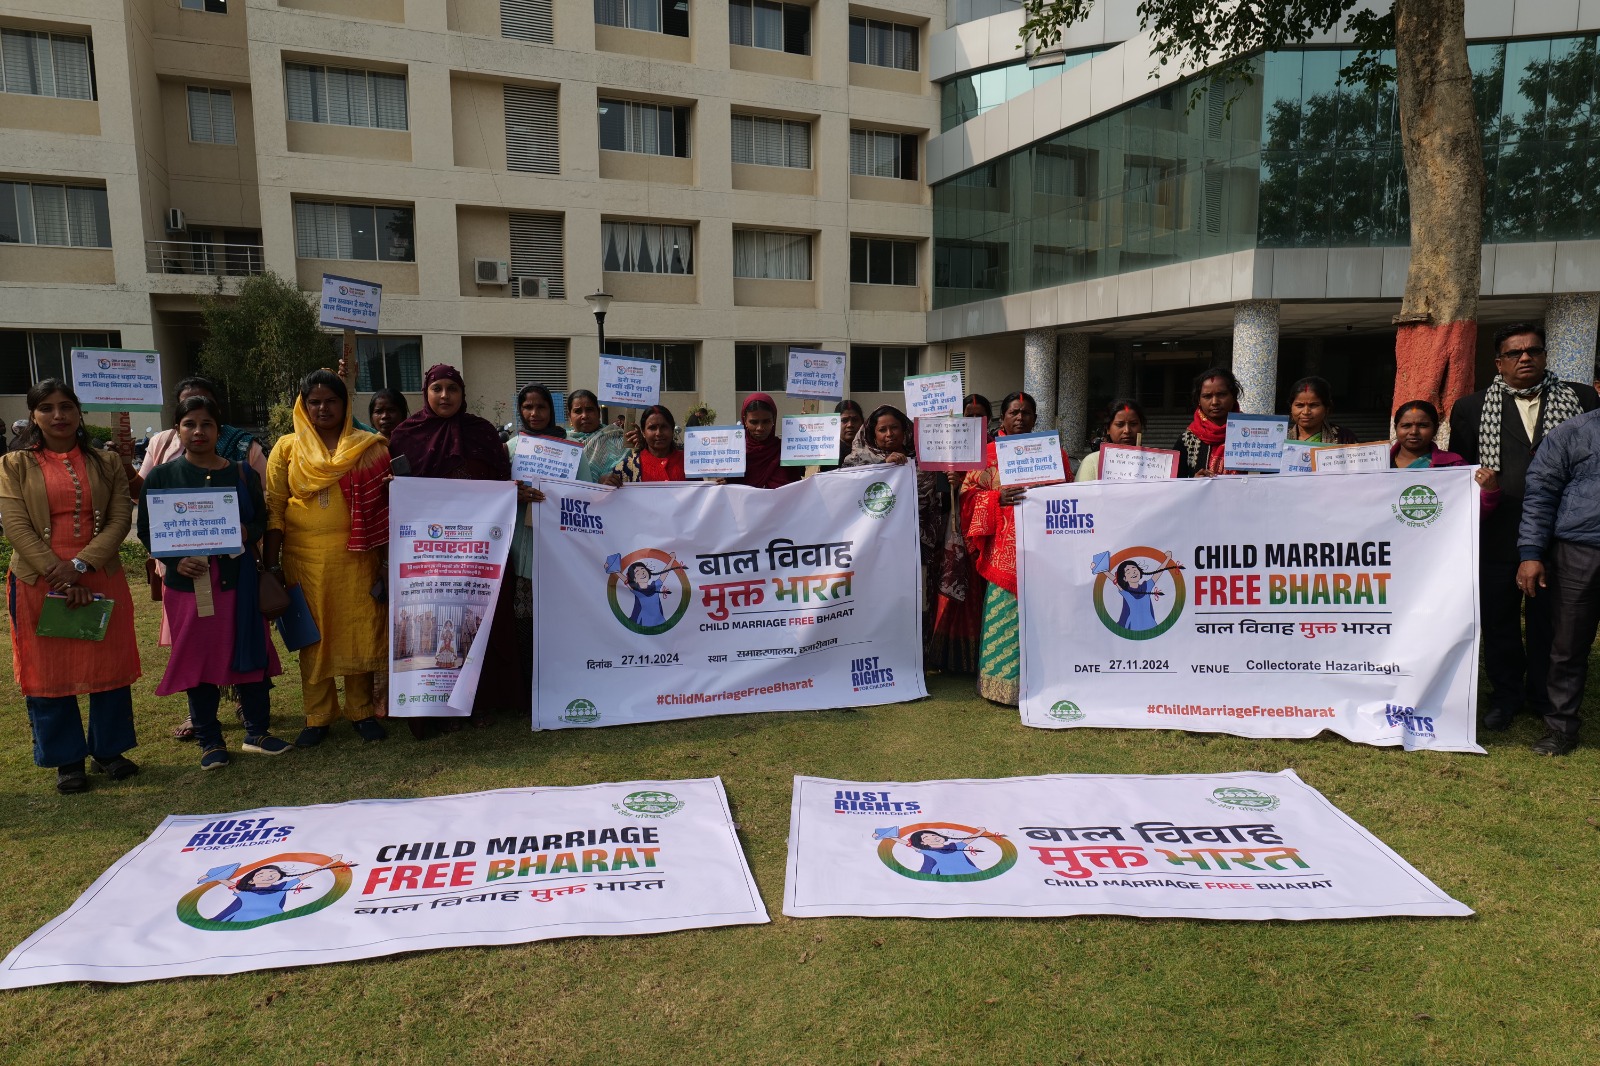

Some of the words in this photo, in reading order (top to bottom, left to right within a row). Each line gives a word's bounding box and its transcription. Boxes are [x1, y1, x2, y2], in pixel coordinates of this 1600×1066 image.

[561, 498, 590, 514] JUST
[1046, 499, 1078, 514] JUST
[163, 520, 177, 530] सुनो
[192, 518, 197, 526] से
[199, 517, 226, 526] देशवासी
[561, 512, 603, 529] RIGHTS
[1046, 513, 1094, 529] RIGHTS
[176, 529, 190, 538] होगी
[192, 528, 208, 536] बच्चों
[210, 527, 219, 535] की
[221, 527, 236, 535] शादी
[413, 540, 490, 554] खबरदार!
[696, 550, 760, 575] बाल
[765, 538, 853, 570] विवाह
[1194, 544, 1258, 569] CHILD
[1265, 542, 1391, 568] MARRIAGE
[699, 579, 766, 621] मुक्त
[772, 571, 854, 603] भारत
[1194, 574, 1261, 605] FREE
[1269, 573, 1391, 604] BHARAT
[699, 622, 730, 632] CHILD
[732, 618, 786, 630] MARRIAGE
[788, 617, 814, 626] FREE
[816, 608, 854, 624] BHARAT
[1195, 623, 1234, 634] बाल
[1238, 619, 1295, 636] विवाह
[1299, 622, 1337, 639] मुक्त
[1342, 623, 1392, 635] भारत
[586, 659, 613, 670] दिनांक
[621, 653, 679, 665] 27.11.2024
[708, 654, 728, 663] स्थान
[736, 647, 797, 658] समाहरणालय,
[851, 656, 879, 672] JUST
[1109, 660, 1170, 670] 27.11.2024
[1191, 664, 1230, 673] VENUE
[1246, 660, 1321, 670] Collectorate
[1325, 660, 1400, 674] Hazaribagh
[852, 668, 893, 686] RIGHTS
[656, 678, 813, 706] #ChildMarriageFreeBharat
[869, 682, 893, 690] CHILDREN
[422, 693, 437, 702] सेवा
[1147, 704, 1335, 719] #ChildMarriageFreeBharat
[834, 791, 891, 802] JUST
[834, 800, 920, 812] RIGHTS
[198, 817, 274, 833] JUST
[1019, 826, 1126, 842] बाल
[1130, 821, 1284, 845] विवाह
[186, 826, 295, 847] RIGHTS
[223, 838, 281, 850] CHILDREN
[375, 840, 476, 863] CHILD
[485, 826, 660, 856] MARRIAGE
[1028, 846, 1149, 879] मुक्त
[1154, 847, 1311, 871] भारत
[362, 861, 477, 895] FREE
[485, 847, 661, 883] BHARAT
[1044, 878, 1099, 887] CHILD
[1103, 879, 1203, 890] MARRIAGE
[1204, 882, 1255, 890] FREE
[1257, 880, 1334, 890] BHARAT
[354, 902, 423, 915] बाल
[430, 890, 523, 910] विवाह
[528, 883, 588, 903] मुक्त
[594, 879, 666, 892] भारत
